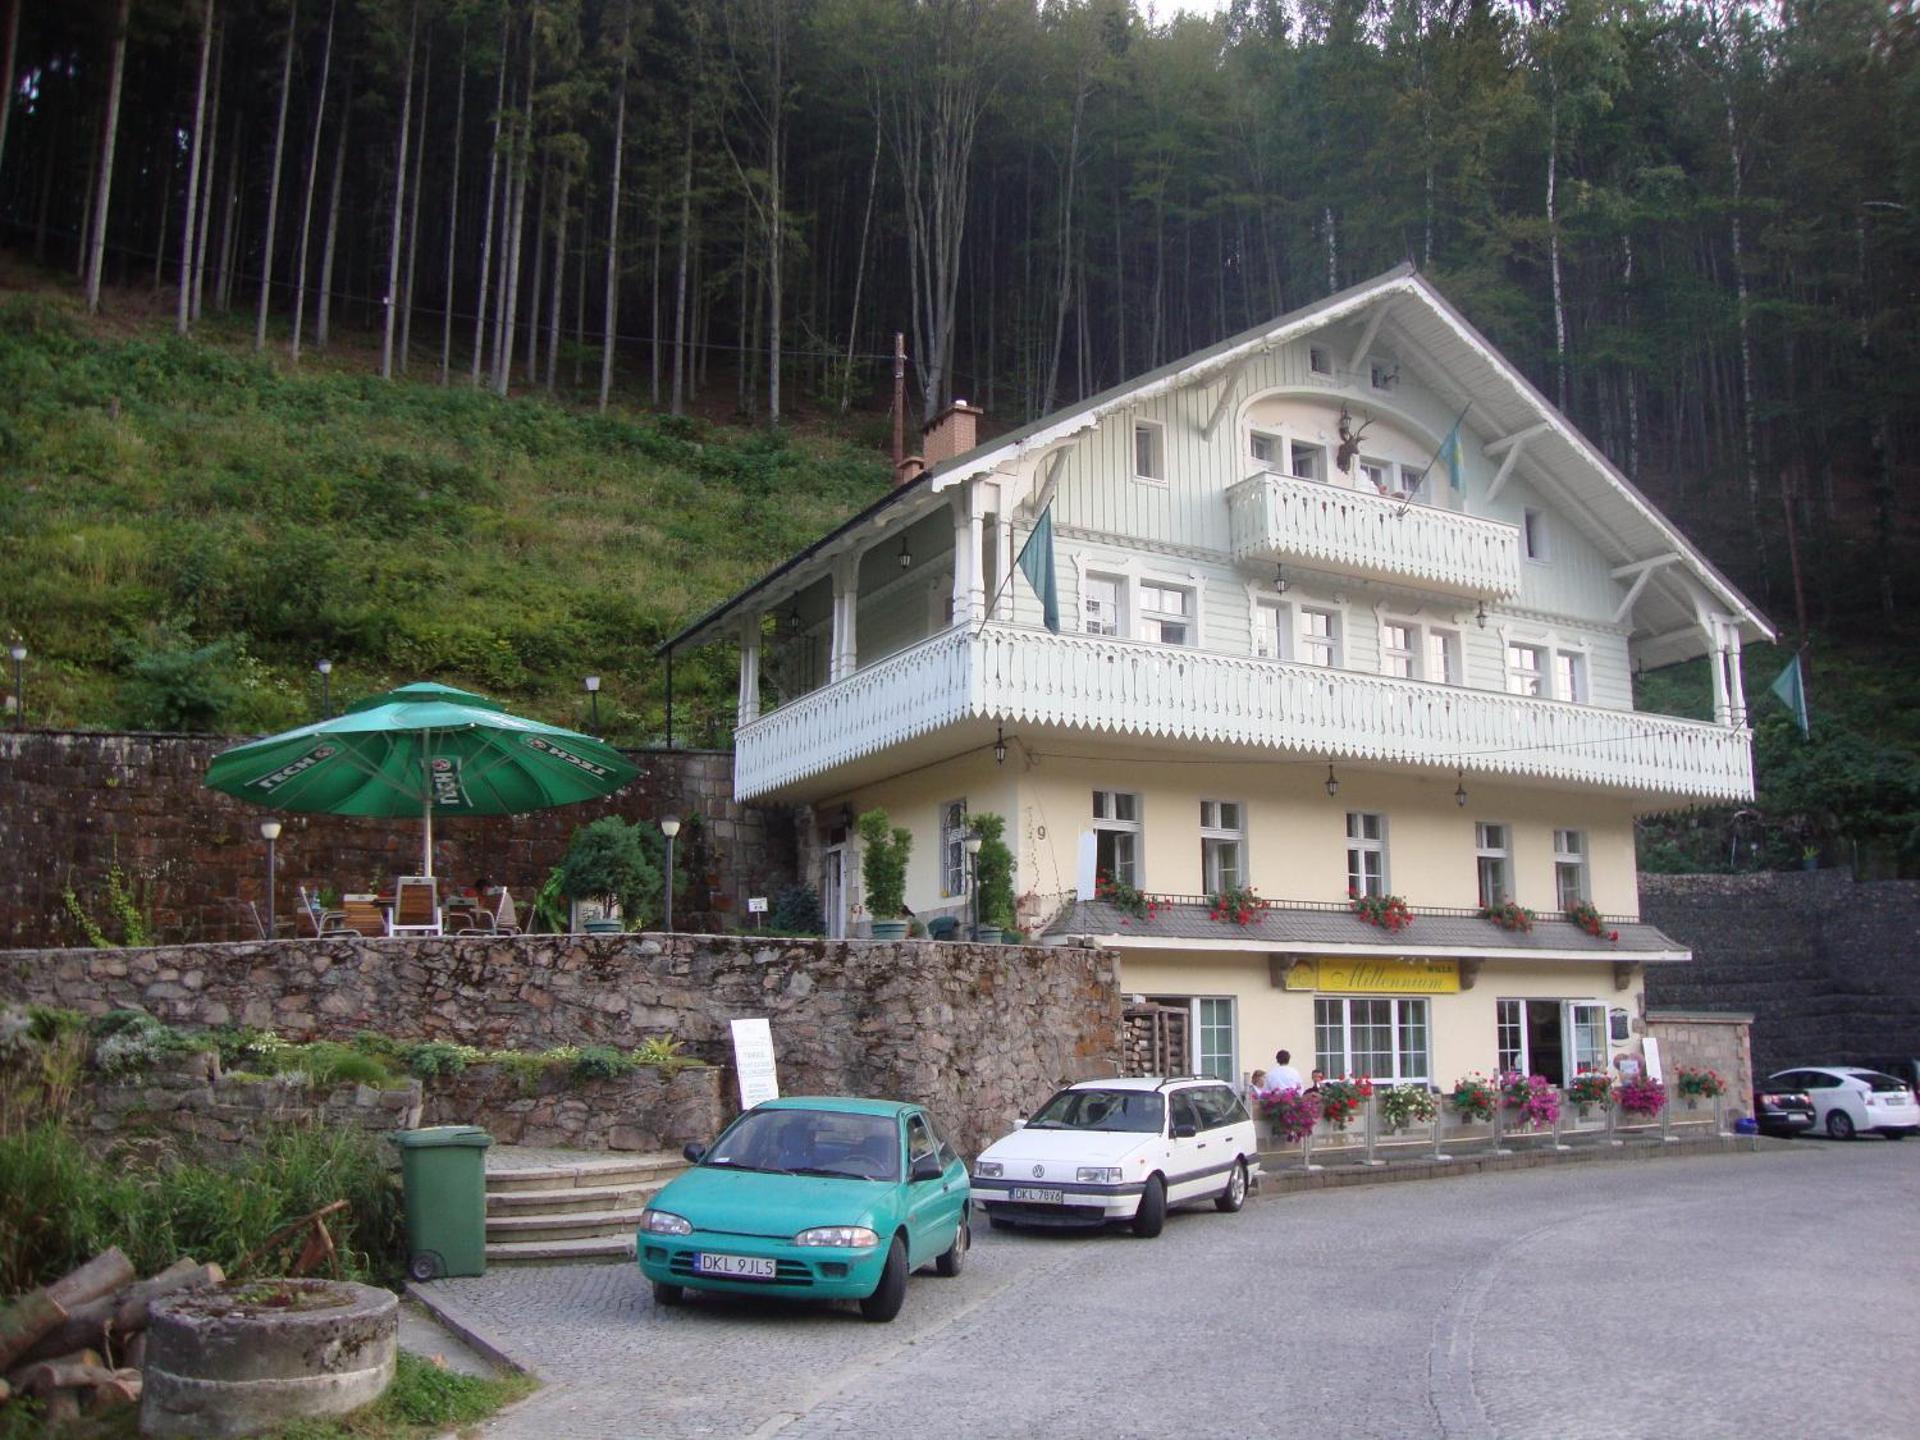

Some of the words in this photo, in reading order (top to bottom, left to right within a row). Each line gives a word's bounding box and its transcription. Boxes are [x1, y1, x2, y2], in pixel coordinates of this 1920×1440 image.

[1332, 962, 1442, 989] Millennium
[1015, 1187, 1036, 1200] DKL
[703, 1255, 733, 1272] DKL
[737, 1259, 773, 1276] 9JL5
